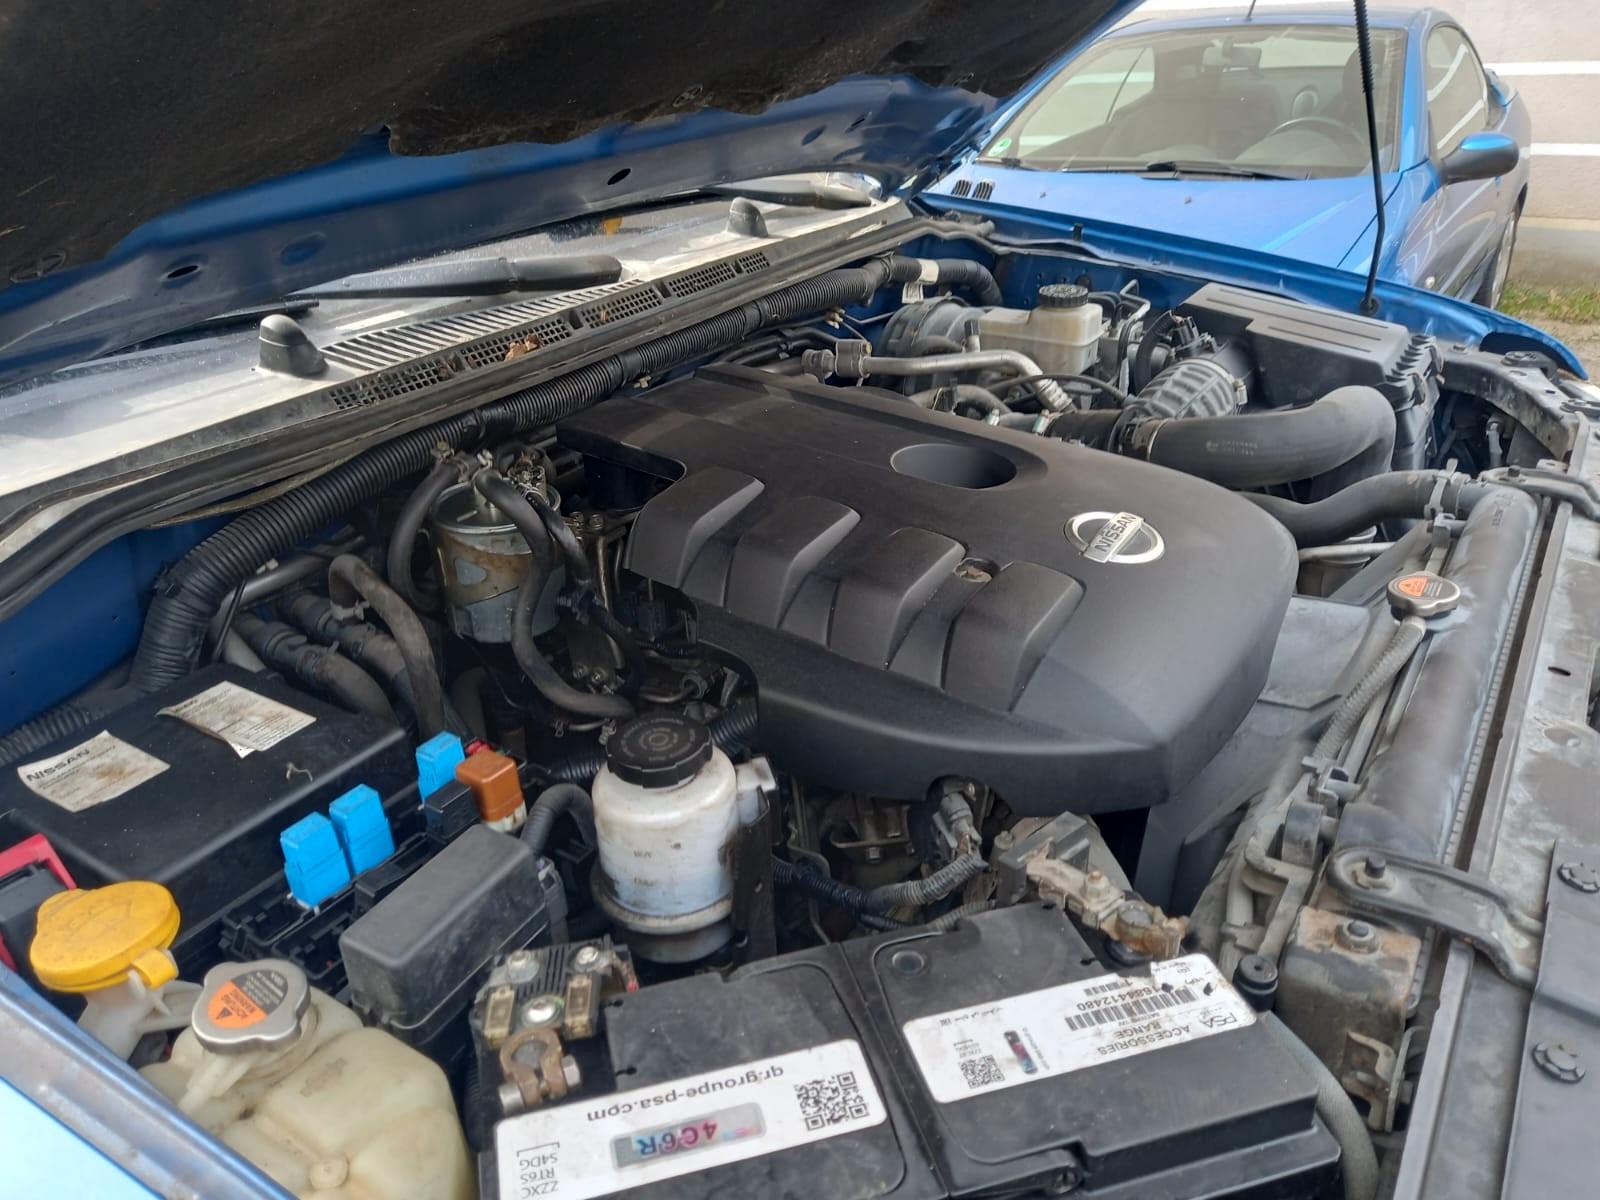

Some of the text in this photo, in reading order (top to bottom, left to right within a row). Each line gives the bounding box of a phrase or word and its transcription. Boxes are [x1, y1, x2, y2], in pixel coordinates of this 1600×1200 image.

[1094, 516, 1137, 552] NISSAN
[26, 749, 90, 782] NISSAN
[1076, 985, 1161, 1012] 1684412480
[1097, 1012, 1238, 1056] PSA ACCESSORIES
[1113, 1022, 1163, 1040] RANGE
[586, 1065, 785, 1121] qr.groupe-psa.com
[636, 1119, 718, 1156] 4C6R
[519, 1152, 558, 1171] S4DG
[520, 1167, 555, 1185] RT6S
[521, 1180, 559, 1199] ZZXC
